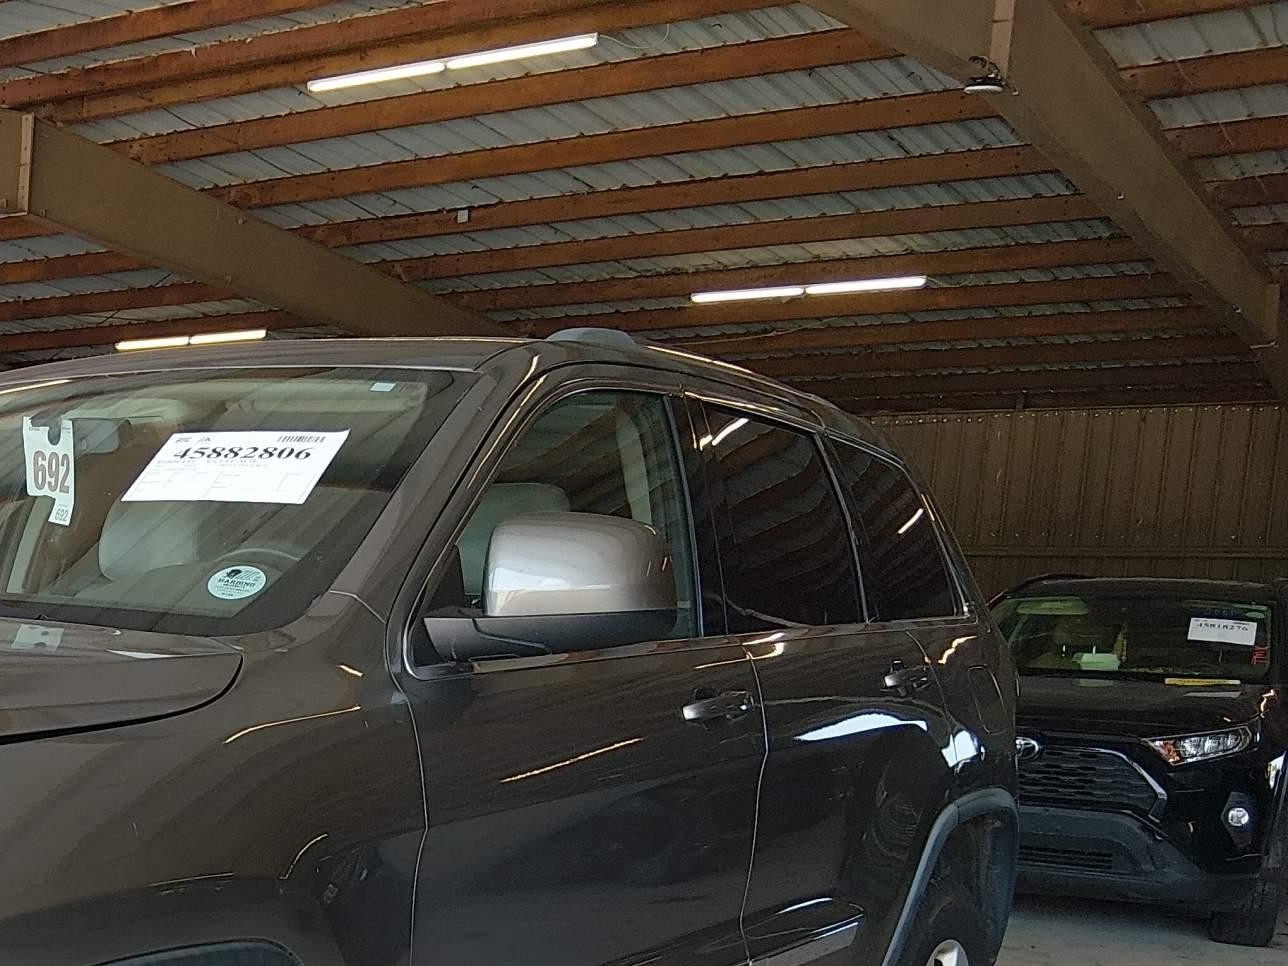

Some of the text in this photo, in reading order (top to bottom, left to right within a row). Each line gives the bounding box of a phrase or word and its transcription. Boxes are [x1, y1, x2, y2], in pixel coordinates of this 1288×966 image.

[173, 446, 314, 460] 45882806
[33, 450, 71, 494] 692
[55, 508, 69, 522] 692
